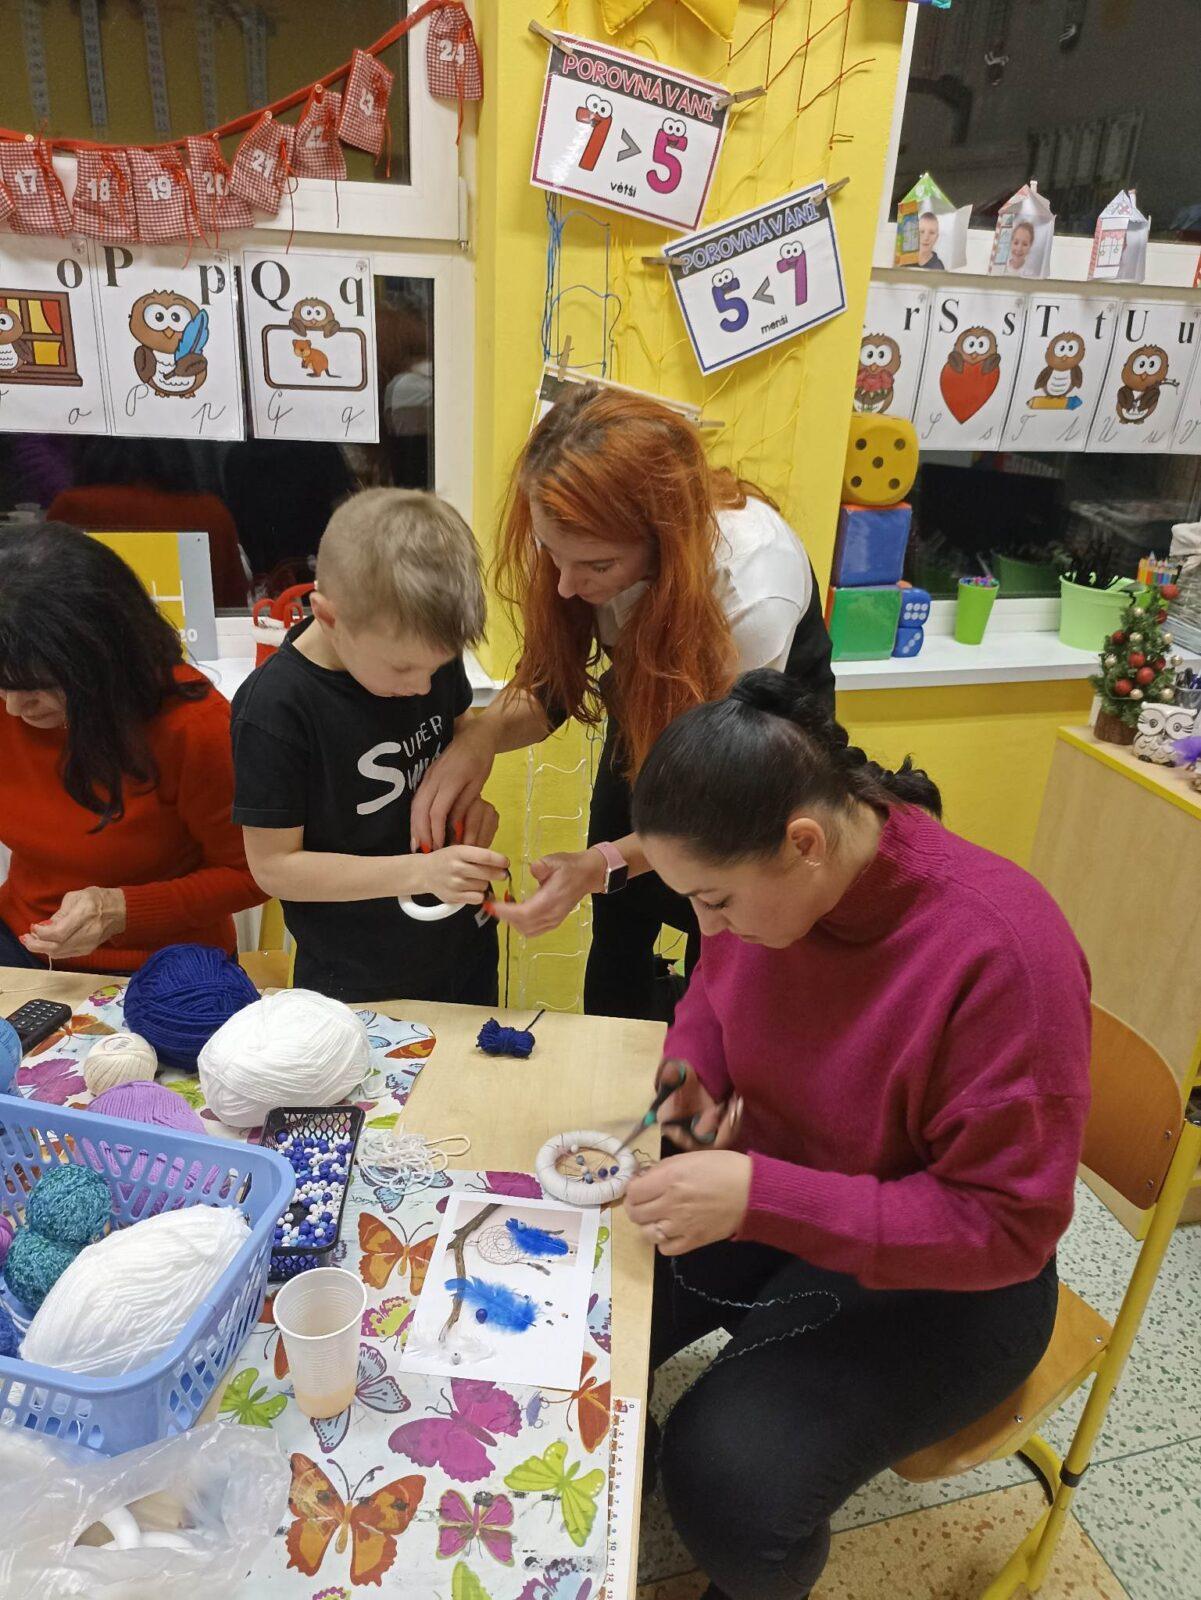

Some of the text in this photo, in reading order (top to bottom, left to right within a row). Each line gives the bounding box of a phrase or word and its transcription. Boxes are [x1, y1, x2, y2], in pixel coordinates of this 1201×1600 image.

[439, 39, 465, 65] 24
[252, 150, 277, 178] 21
[646, 125, 688, 194] 5
[14, 169, 37, 195] 17
[87, 177, 110, 201] 18
[146, 176, 172, 200] 19
[103, 246, 226, 305] P p
[251, 260, 365, 317] Q q
[712, 274, 749, 332] 5
[904, 306, 920, 331] r
[939, 298, 1016, 336] S s
[1036, 305, 1107, 340] T t
[1126, 310, 1195, 344] U u
[610, 1541, 616, 1551] 10
[609, 1558, 615, 1566] 11
[608, 1573, 614, 1582] 12
[607, 1589, 613, 1599] 13
